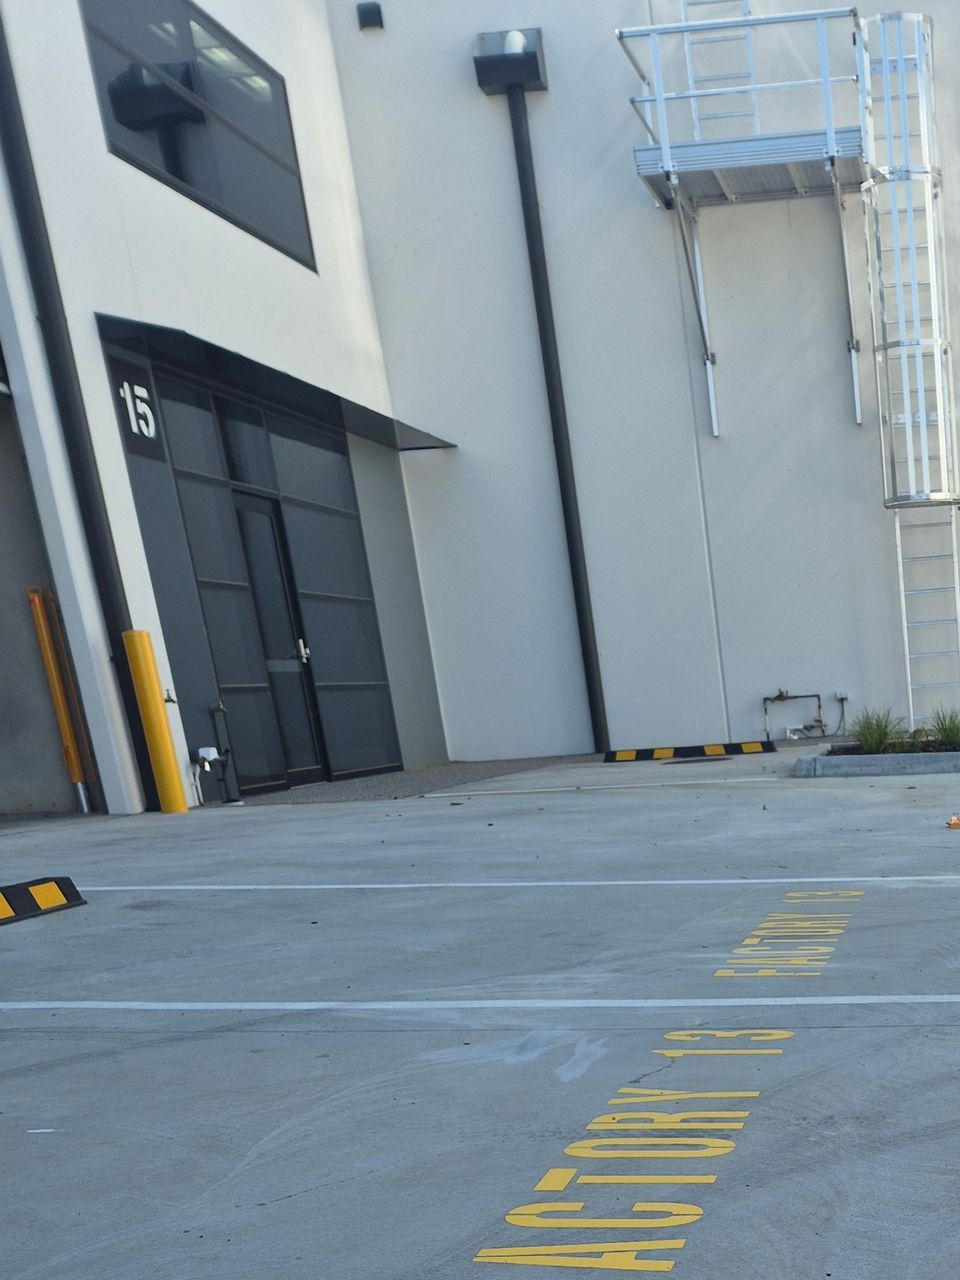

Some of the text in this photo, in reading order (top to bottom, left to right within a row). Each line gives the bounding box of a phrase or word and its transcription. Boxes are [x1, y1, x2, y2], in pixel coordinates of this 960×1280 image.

[119, 381, 156, 438] 15
[713, 889, 865, 977] FACTORY 13
[651, 1028, 795, 1058] 13
